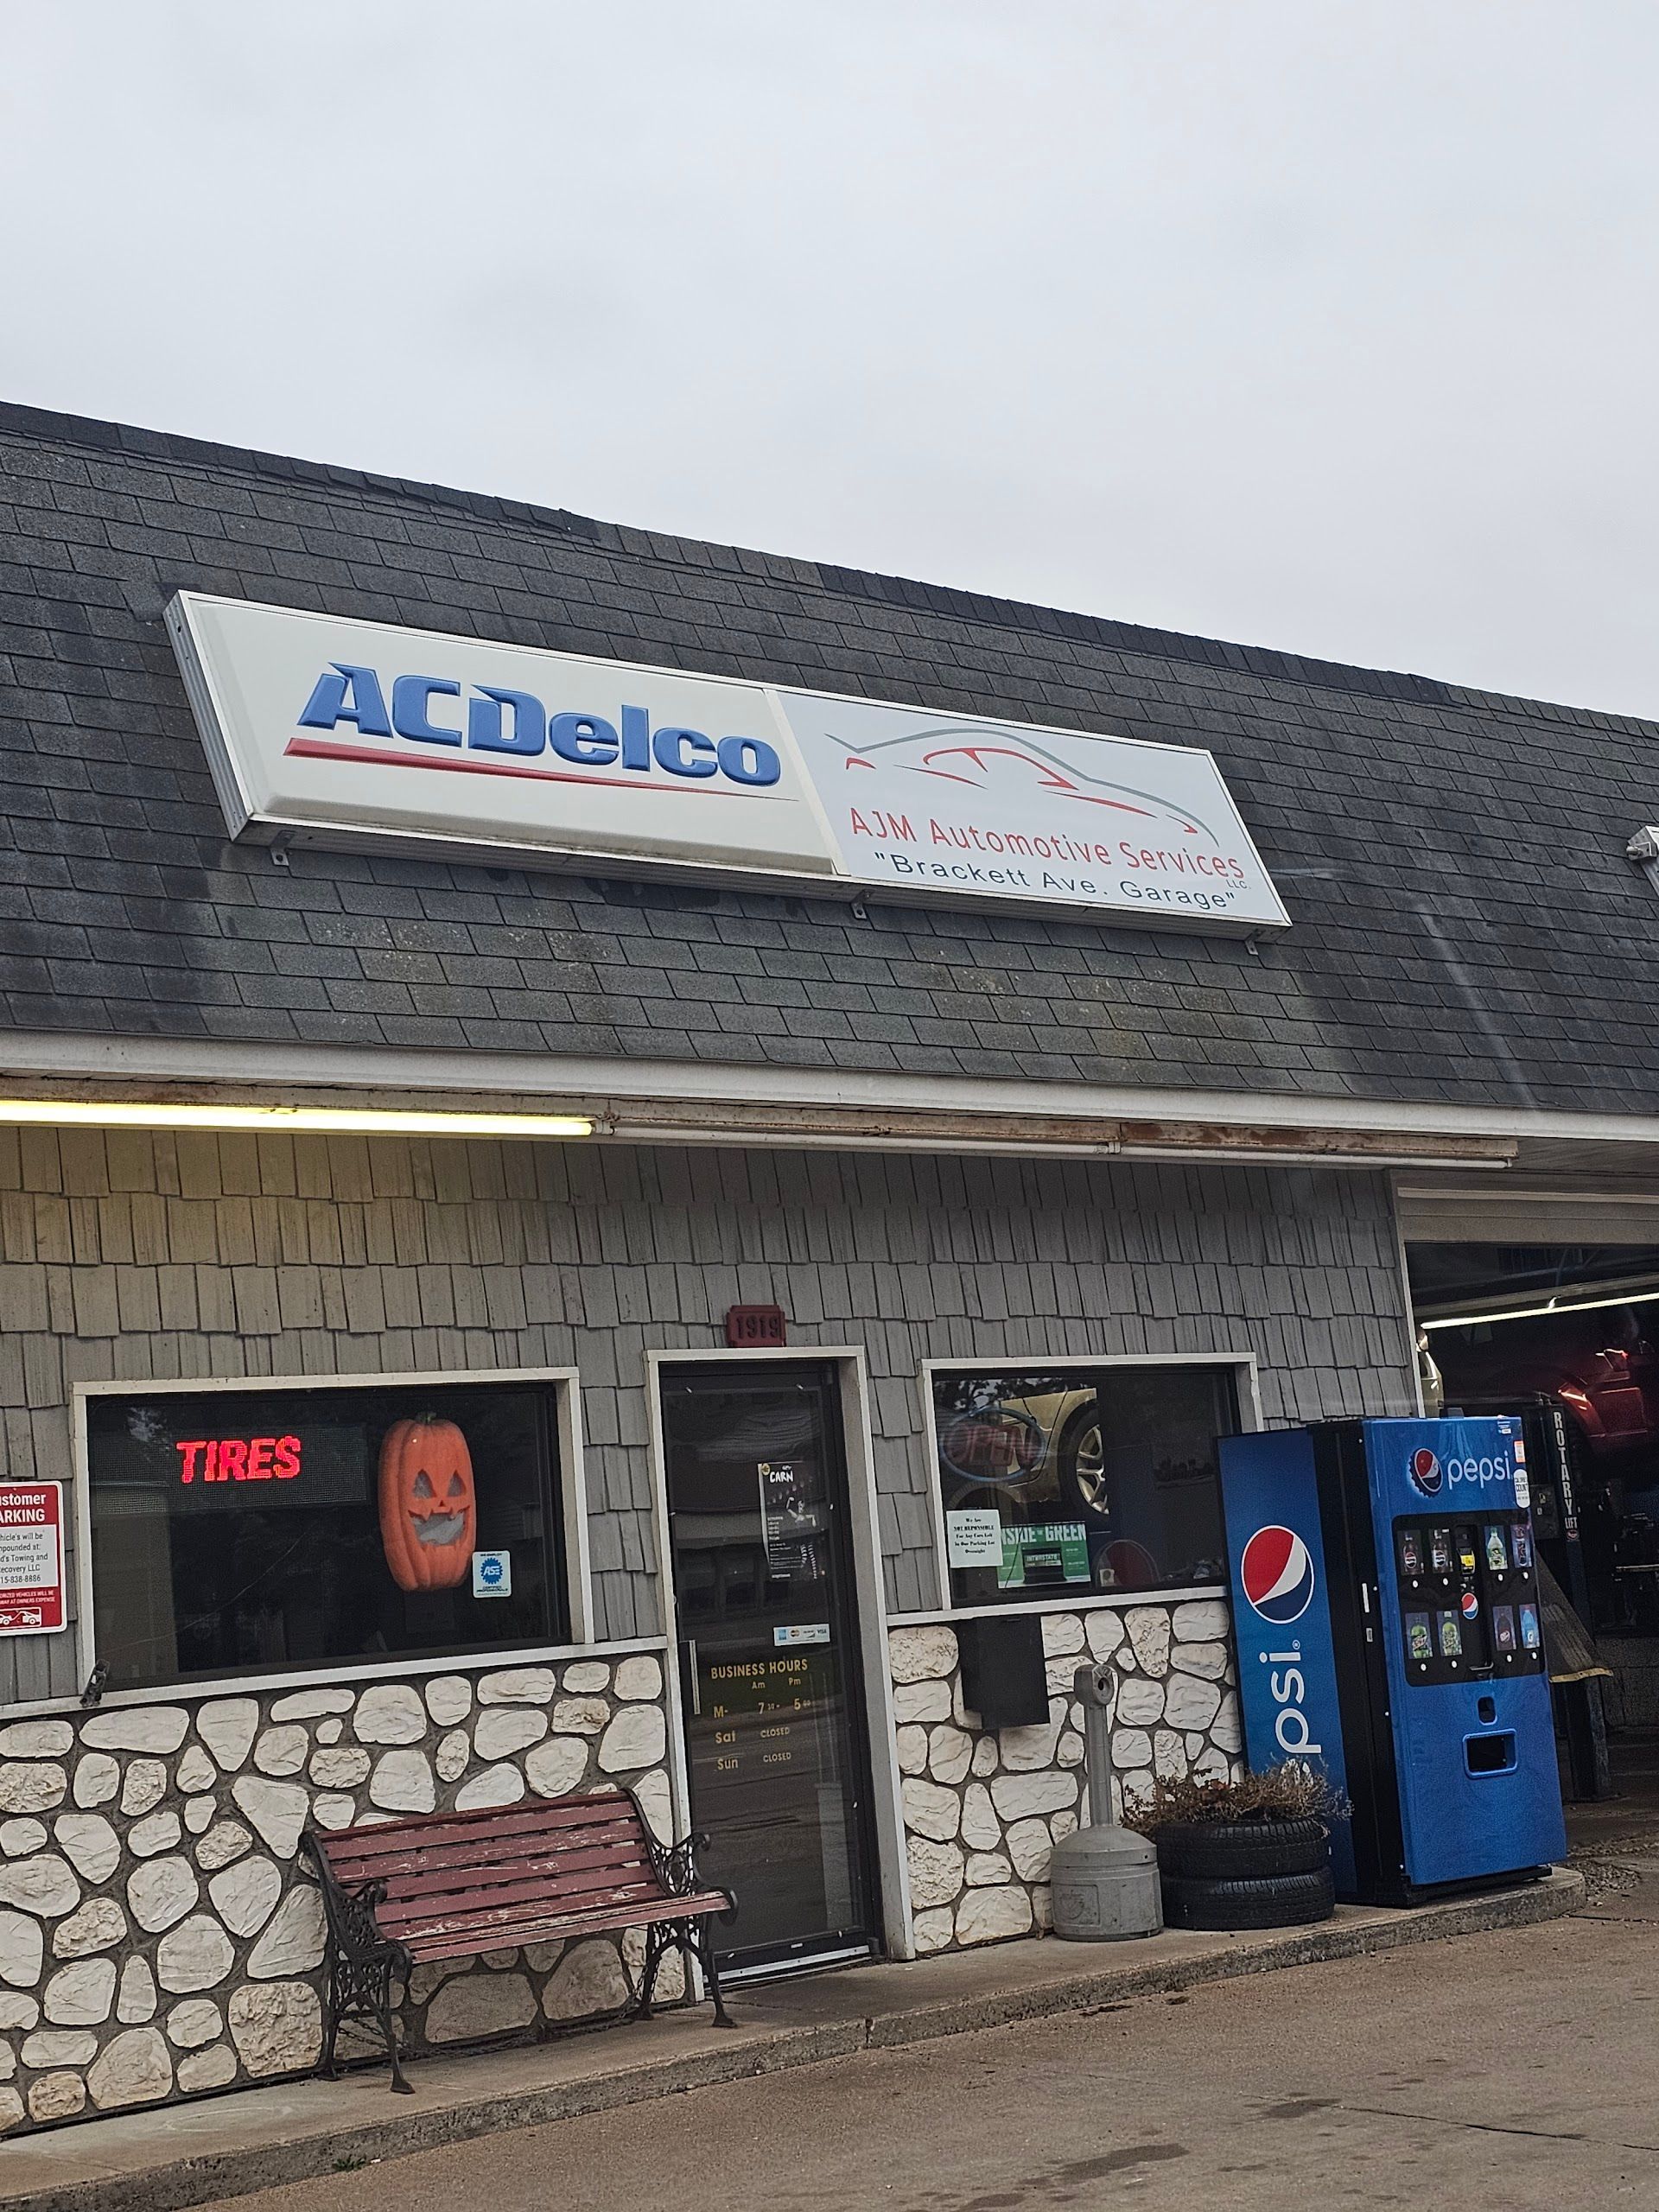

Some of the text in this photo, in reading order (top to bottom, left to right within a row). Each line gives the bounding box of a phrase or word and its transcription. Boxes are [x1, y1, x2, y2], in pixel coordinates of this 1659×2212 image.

[297, 662, 780, 786] ACDelco
[850, 807, 1244, 879] AJM Automotive Services
[874, 851, 1235, 910] "Brackett Ave. Garage"
[736, 1315, 781, 1339] 1919
[176, 1435, 302, 1484] TIRES
[1553, 1411, 1573, 1516] ROTARY
[1447, 1450, 1511, 1491] pepsi
[0, 1493, 47, 1506] stomer
[0, 1509, 46, 1523] ARKING
[1564, 1516, 1578, 1529] LIFT
[0, 1533, 21, 1541] hicle's
[1001, 1523, 1087, 1545] NSIDE GREEN
[11, 1554, 35, 1563] Towing
[0, 1565, 26, 1573] ecovery
[0, 1574, 41, 1583] 15-838-8886
[711, 1658, 808, 1679] BUSINESS HOURS
[752, 1677, 801, 1690] Am Pm
[758, 1702, 766, 1715] 7
[793, 1698, 801, 1711] 5
[1259, 1651, 1322, 1756] psi
[715, 1727, 791, 1744] Sat CLOSED
[717, 1752, 791, 1770] Sun CLOSED
